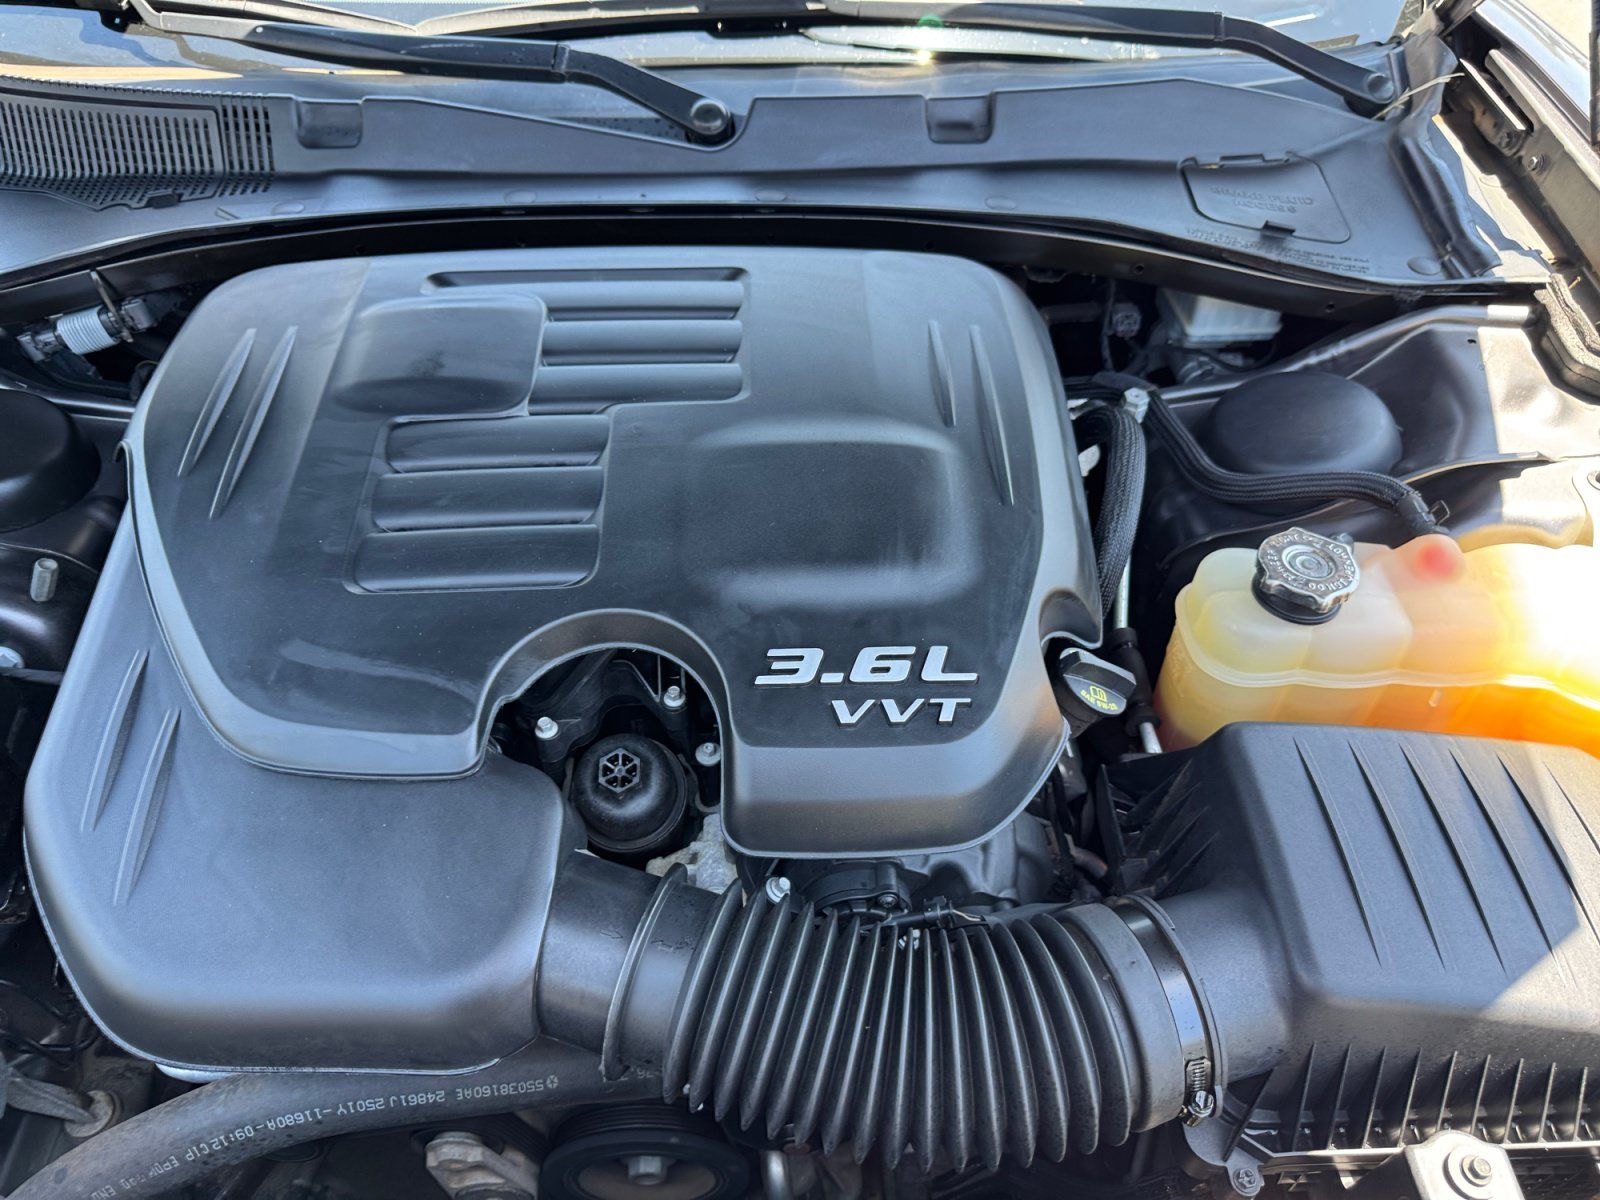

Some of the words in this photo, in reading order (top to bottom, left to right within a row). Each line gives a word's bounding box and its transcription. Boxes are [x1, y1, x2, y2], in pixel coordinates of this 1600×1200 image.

[754, 645, 979, 686] 3.6L
[831, 697, 972, 727] VVT
[390, 1089, 446, 1108] 24861J
[456, 1079, 544, 1100] 55038160AE
[337, 1097, 385, 1116] 2501Y
